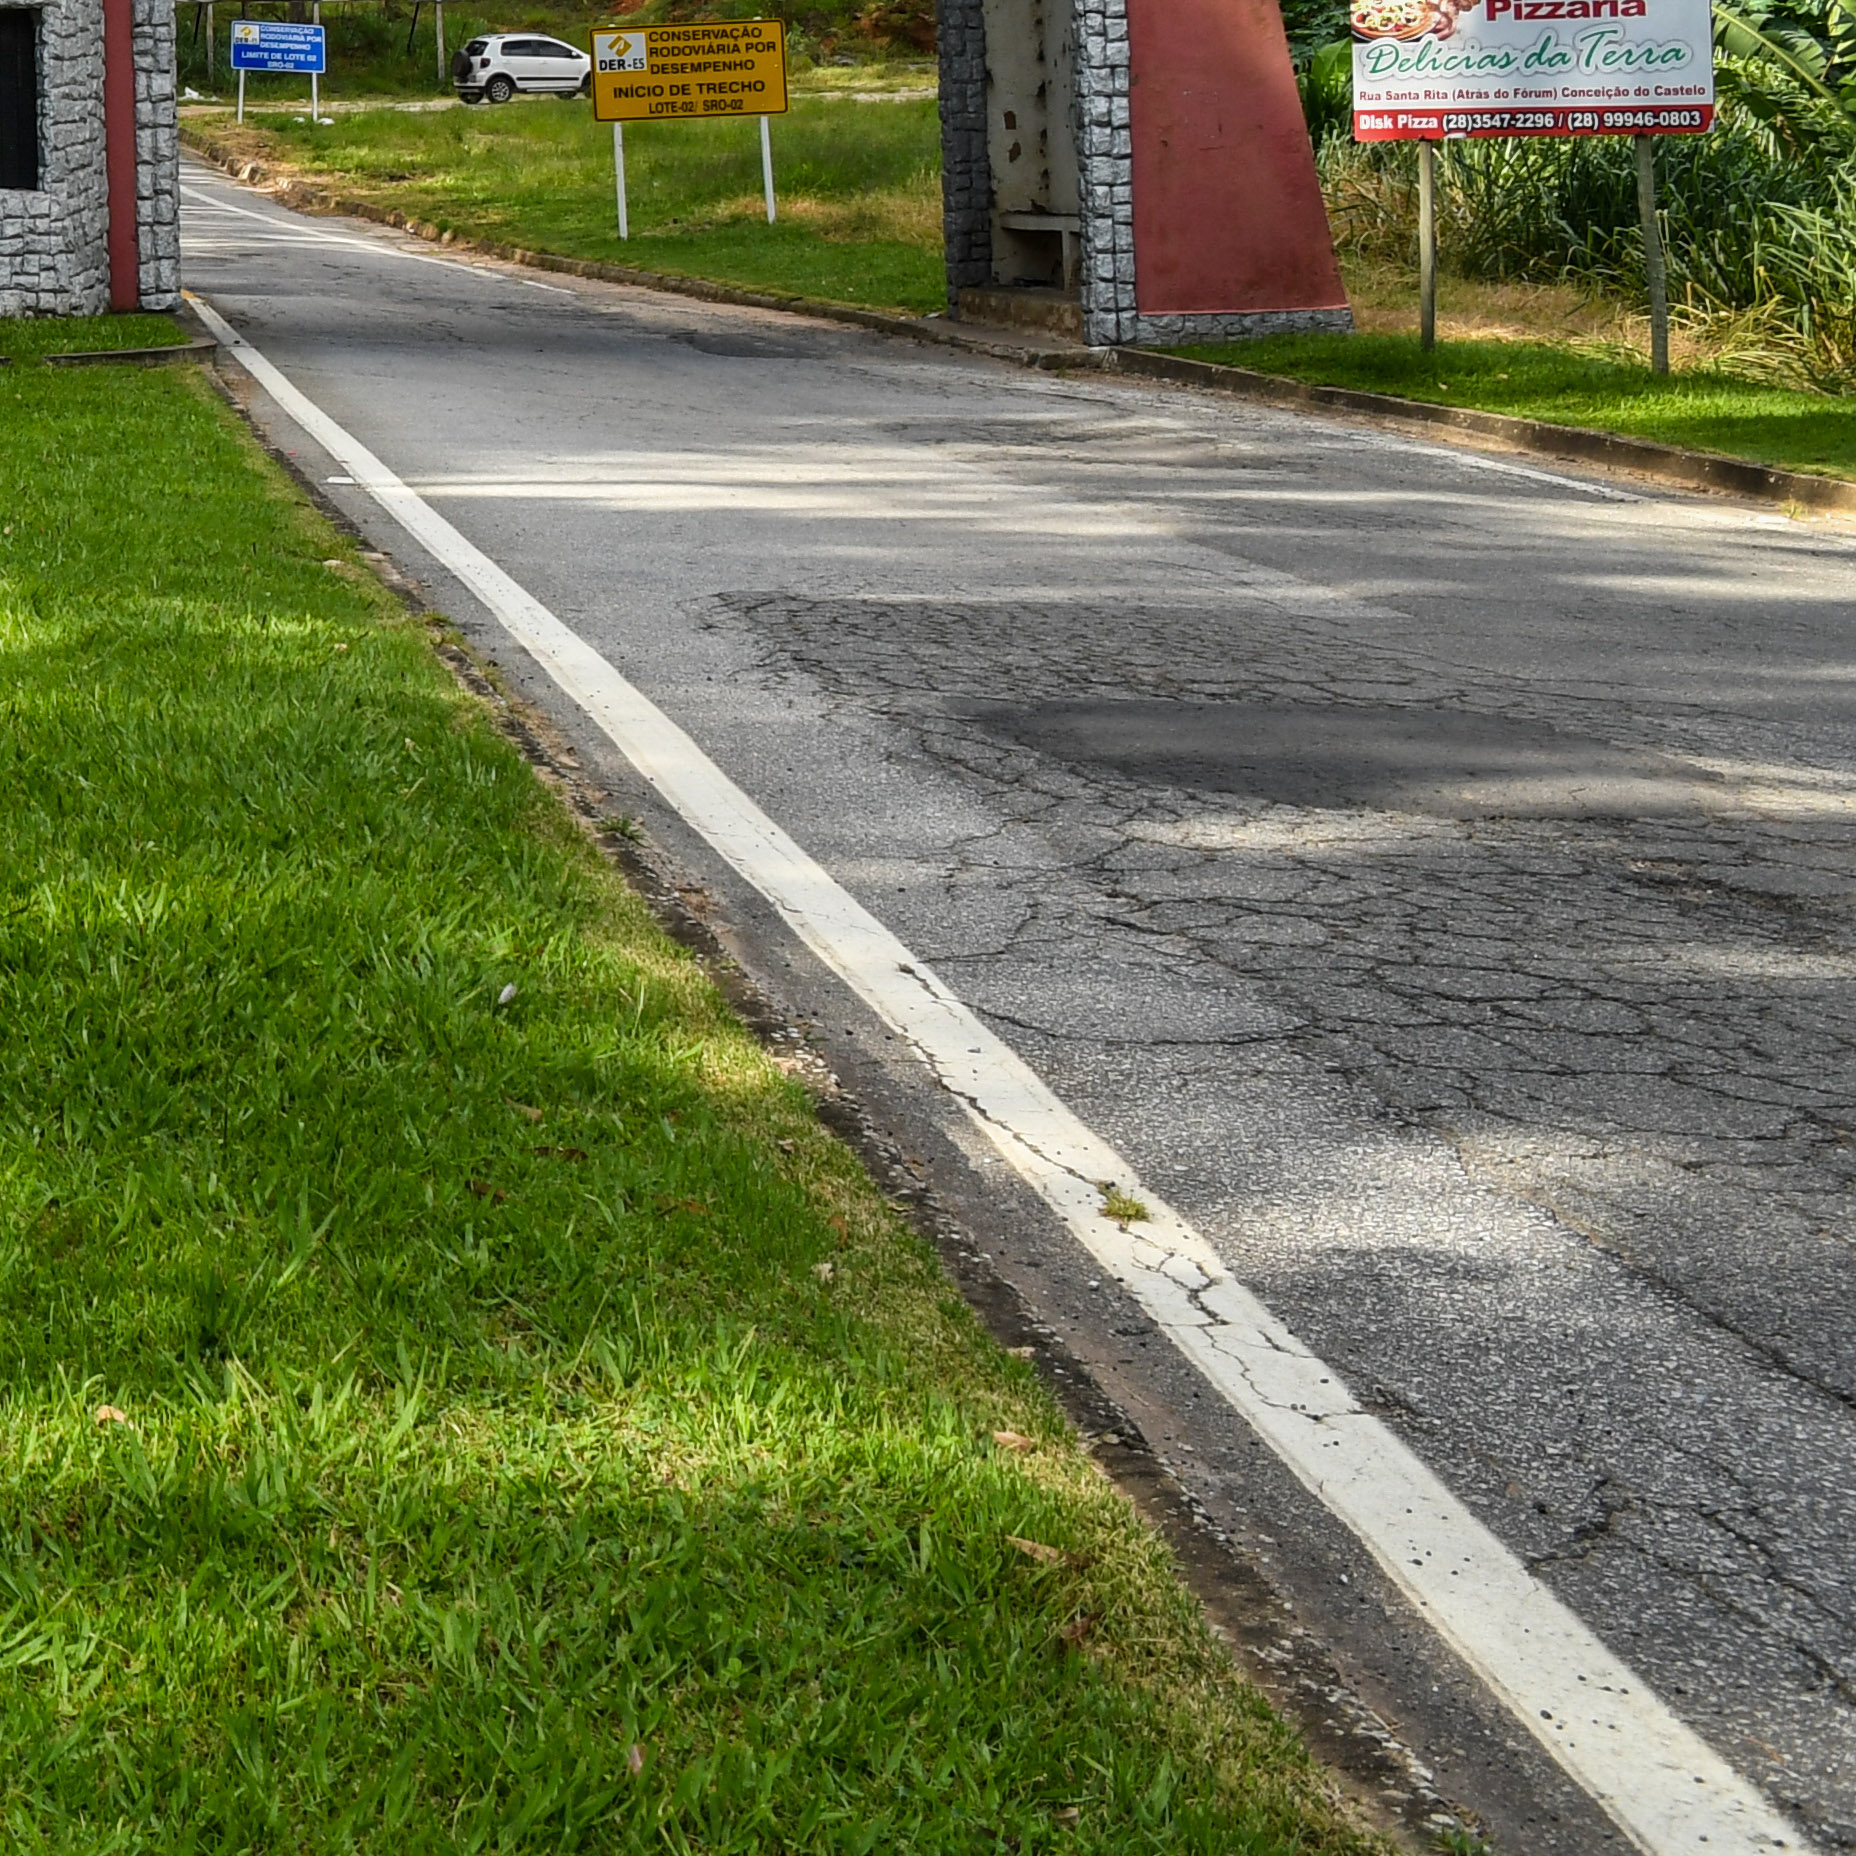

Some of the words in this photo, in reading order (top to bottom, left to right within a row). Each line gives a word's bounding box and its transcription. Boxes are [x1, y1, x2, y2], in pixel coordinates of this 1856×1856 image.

[648, 25, 763, 43] CONSERVAÇÃO
[241, 51, 269, 59] LIMITE
[270, 52, 283, 60] DE
[283, 53, 306, 61] LOTE
[649, 42, 741, 58] RODOVIÁRIA
[745, 41, 777, 53] POR
[1366, 37, 1520, 75] Delícias
[1524, 35, 1572, 69] da
[1576, 29, 1687, 69] Terra
[599, 57, 645, 72] DER-ES
[650, 59, 756, 75] DESEMPENHO
[613, 83, 665, 99] INÍCIO
[669, 83, 692, 97] DE
[695, 79, 766, 95] TRECHO
[1359, 91, 1382, 101] Rua
[1385, 90, 1420, 101] Santa
[1423, 89, 1449, 100] Rita
[1452, 88, 1490, 102] (Atrás
[1493, 87, 1510, 99] do
[1513, 87, 1558, 101] Fórum)
[1561, 86, 1630, 100] Conceição
[1633, 85, 1650, 97] do
[1654, 84, 1706, 96] Castelo
[702, 98, 744, 112] SRO-02
[1359, 114, 1394, 130] Disk
[1397, 113, 1439, 129] Pizza
[1442, 112, 1554, 132] (28)3547-2296
[1567, 112, 1599, 131] (28)
[1603, 110, 1701, 127] 99946-0803
